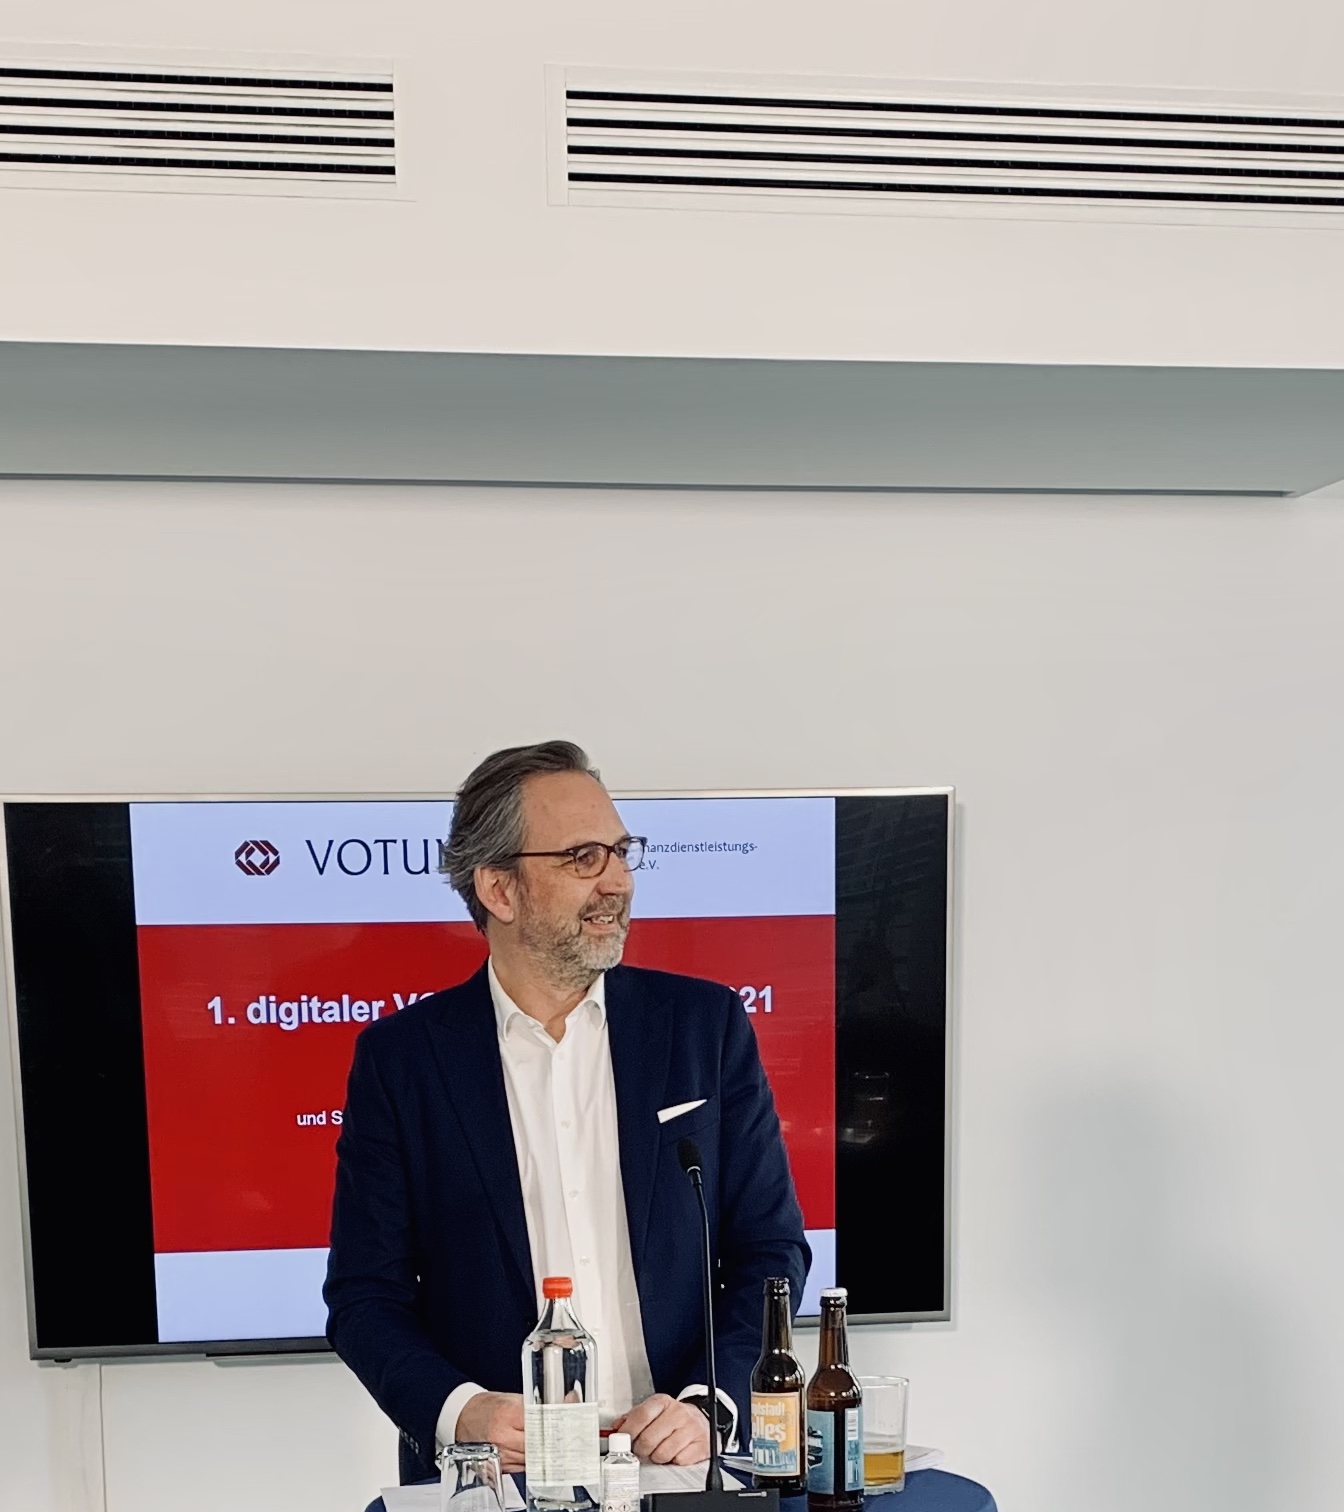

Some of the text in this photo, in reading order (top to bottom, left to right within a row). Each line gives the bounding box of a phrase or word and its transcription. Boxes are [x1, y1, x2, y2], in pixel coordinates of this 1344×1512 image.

[643, 841, 758, 855] nanzdienstleistungs-
[207, 996, 236, 1024] 1.
[246, 994, 385, 1031] digitaler
[729, 985, 773, 1013] 21
[296, 1109, 344, 1126] und S
